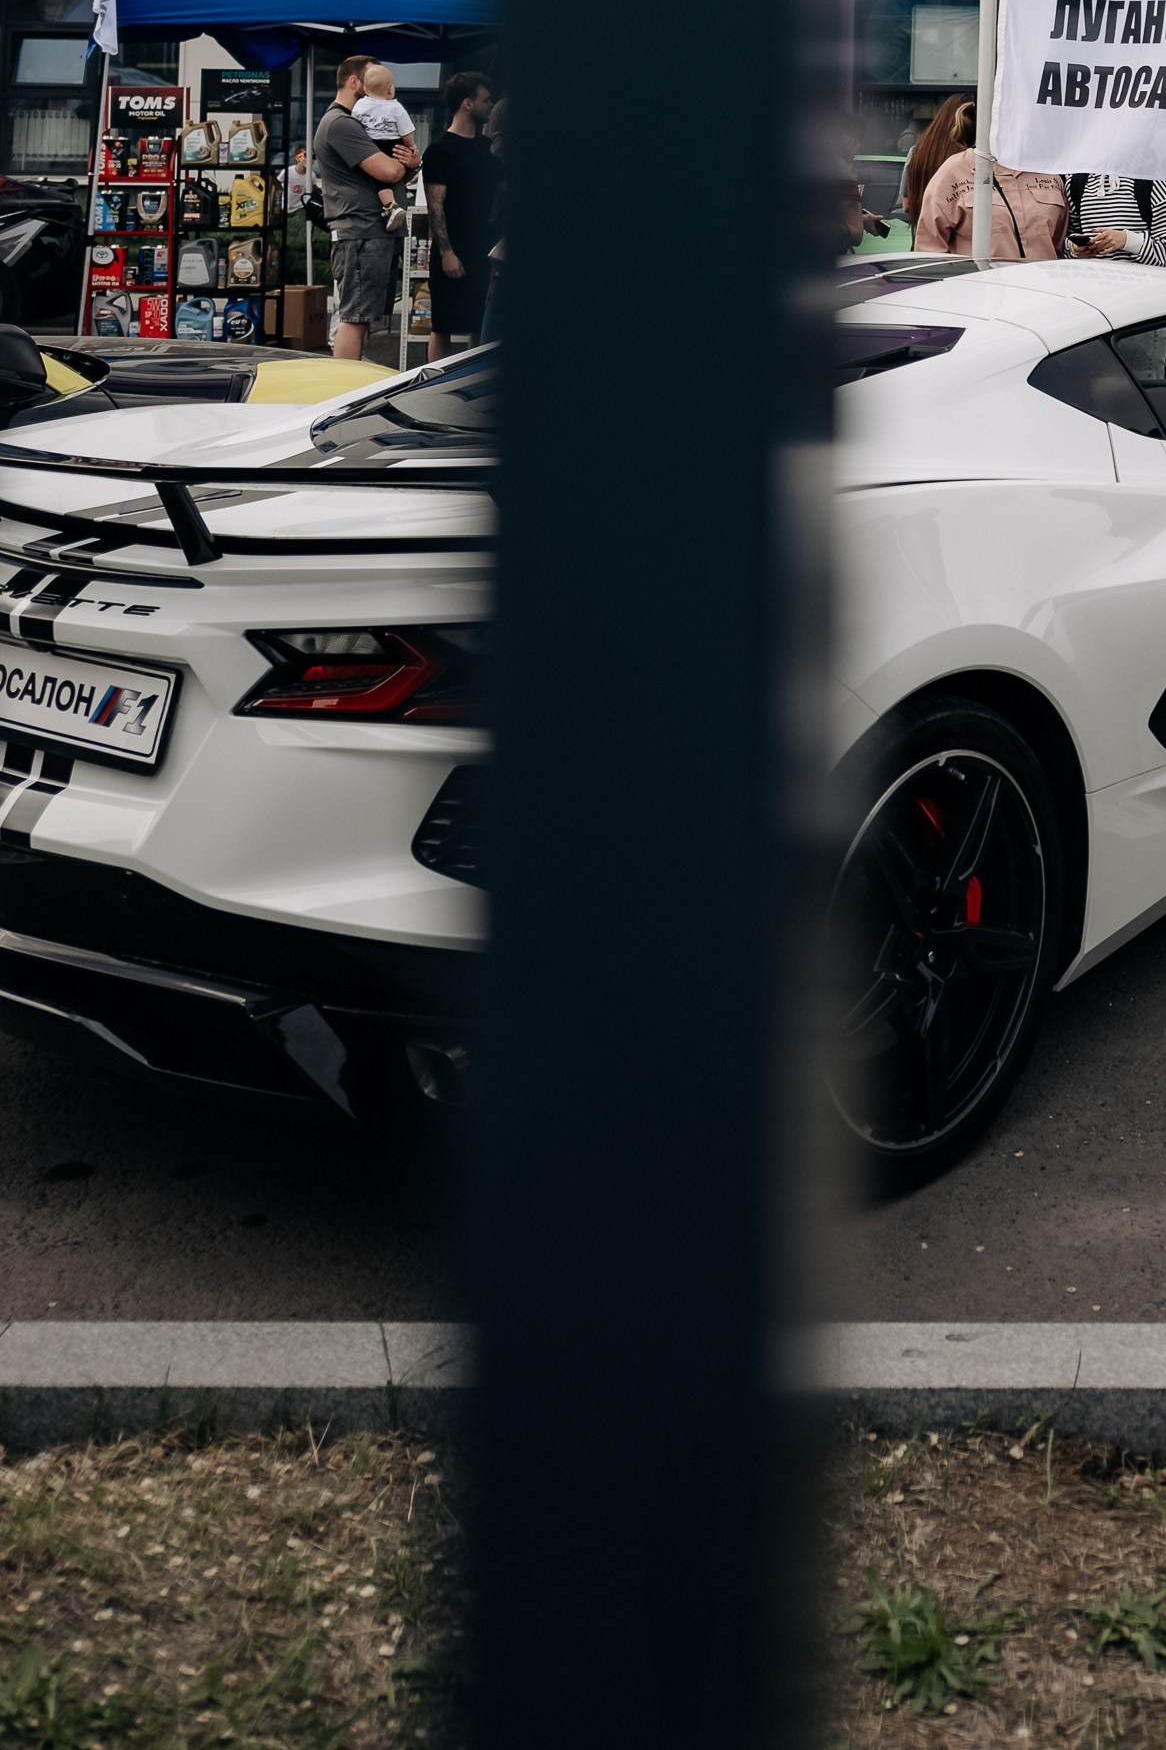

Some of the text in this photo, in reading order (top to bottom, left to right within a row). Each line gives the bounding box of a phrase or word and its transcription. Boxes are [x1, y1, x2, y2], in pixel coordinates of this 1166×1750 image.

[118, 96, 176, 110] TOMS
[160, 298, 169, 332] XADO
[97, 687, 160, 736] F1
